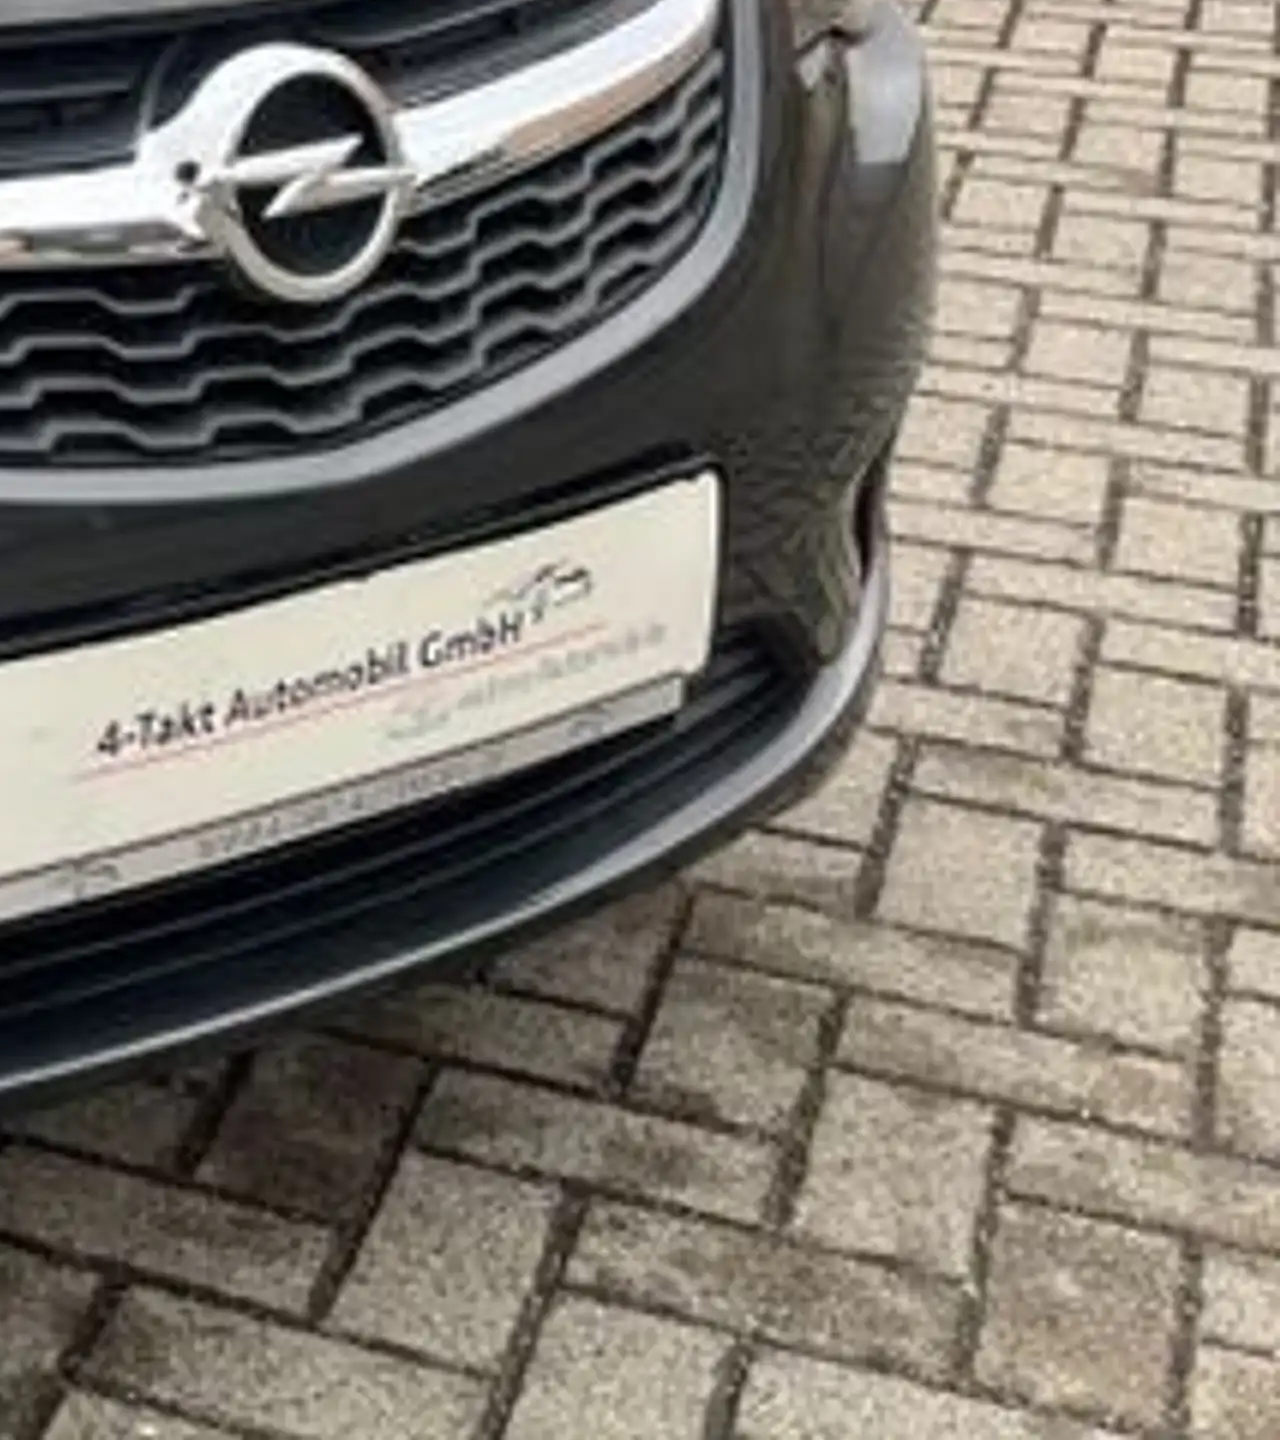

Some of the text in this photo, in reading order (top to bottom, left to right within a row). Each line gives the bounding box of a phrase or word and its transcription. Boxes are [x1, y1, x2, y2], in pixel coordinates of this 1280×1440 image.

[95, 702, 218, 758] 4-Takt
[223, 641, 410, 725] Automobil
[416, 610, 526, 670] GmbH
